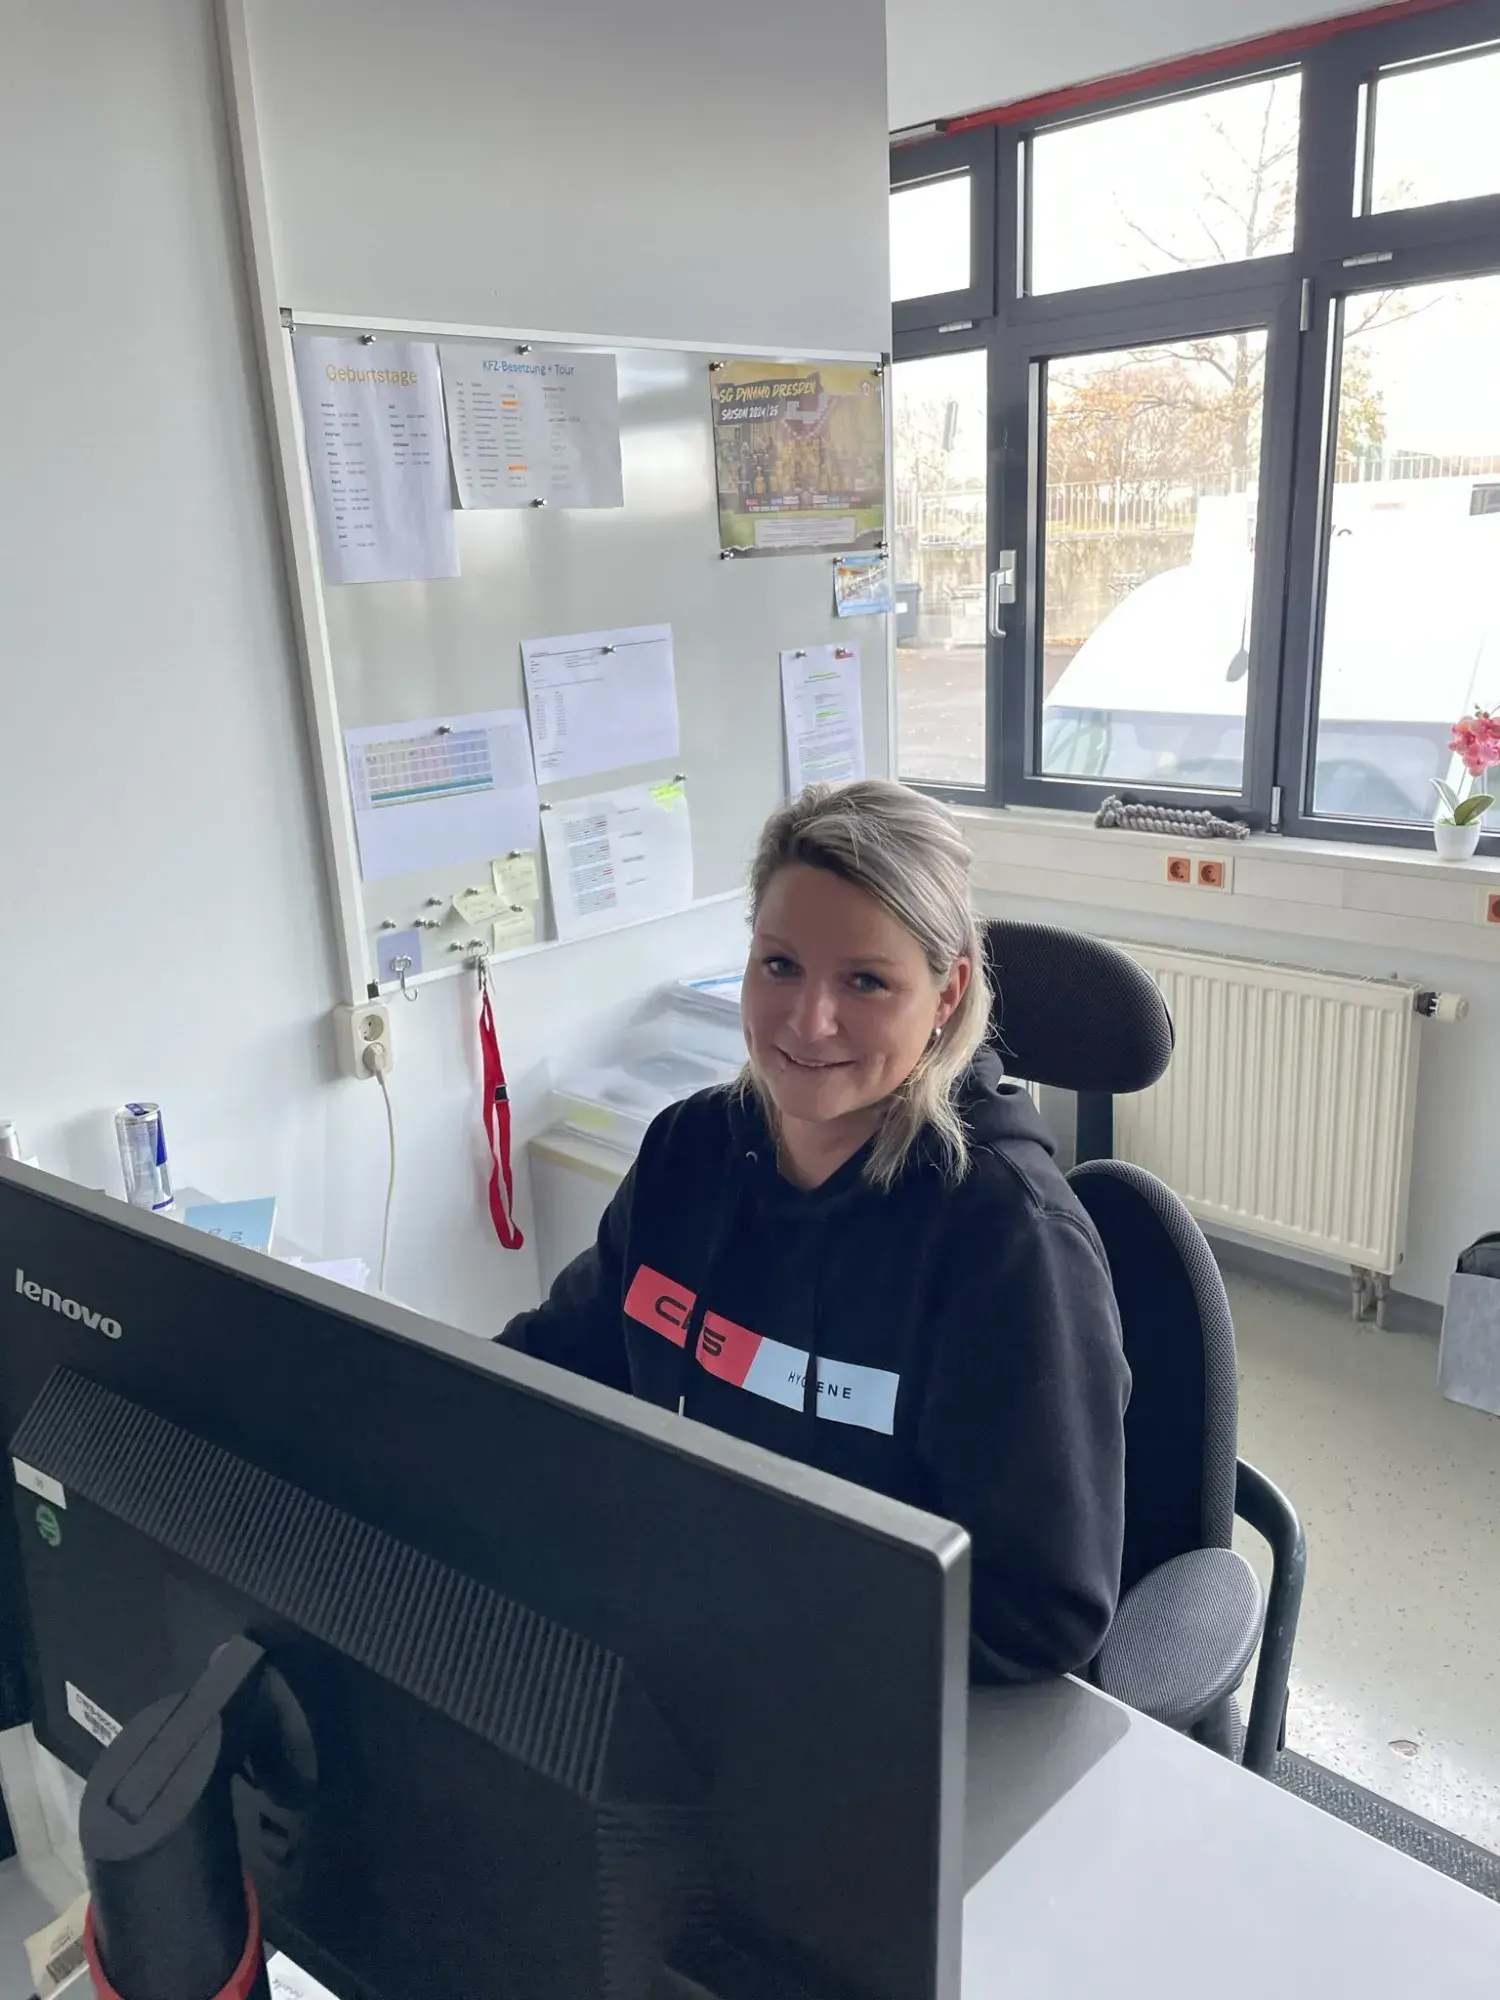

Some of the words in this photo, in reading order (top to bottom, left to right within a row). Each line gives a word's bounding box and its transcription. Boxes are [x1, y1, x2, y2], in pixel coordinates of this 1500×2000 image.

[325, 363, 417, 387] Geburtstage
[482, 360, 546, 376] KFZ-Besetzung
[554, 364, 575, 375] Tour
[719, 387, 734, 403] SG
[735, 384, 770, 402] DYNAMO
[771, 380, 817, 398] DRESDEN
[721, 406, 749, 421] SAISON
[15, 1267, 123, 1340] lenovo
[654, 1295, 727, 1357] CS
[787, 1370, 852, 1400] HYENE
